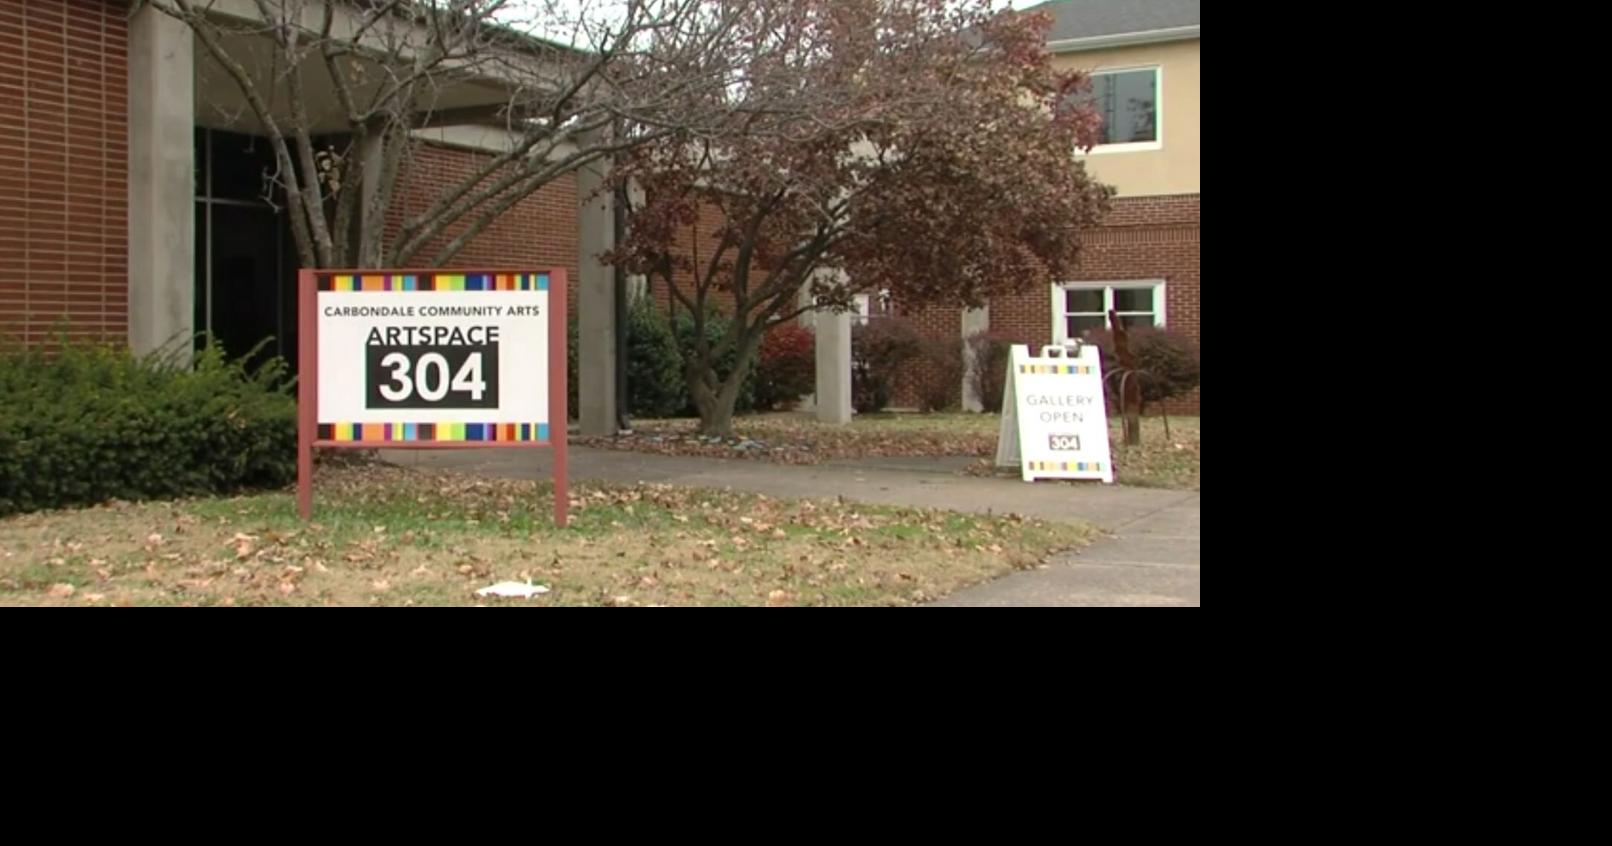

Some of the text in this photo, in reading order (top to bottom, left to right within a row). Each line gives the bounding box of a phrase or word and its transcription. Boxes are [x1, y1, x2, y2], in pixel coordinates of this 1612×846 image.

[324, 305, 540, 317] CARBONDALE COMMUNITY ARTS
[366, 326, 499, 346] ARTSPACE
[379, 352, 486, 402] 304
[1026, 394, 1094, 407] GALLERY
[1040, 411, 1084, 423] OPEN
[1051, 436, 1078, 449] 304
